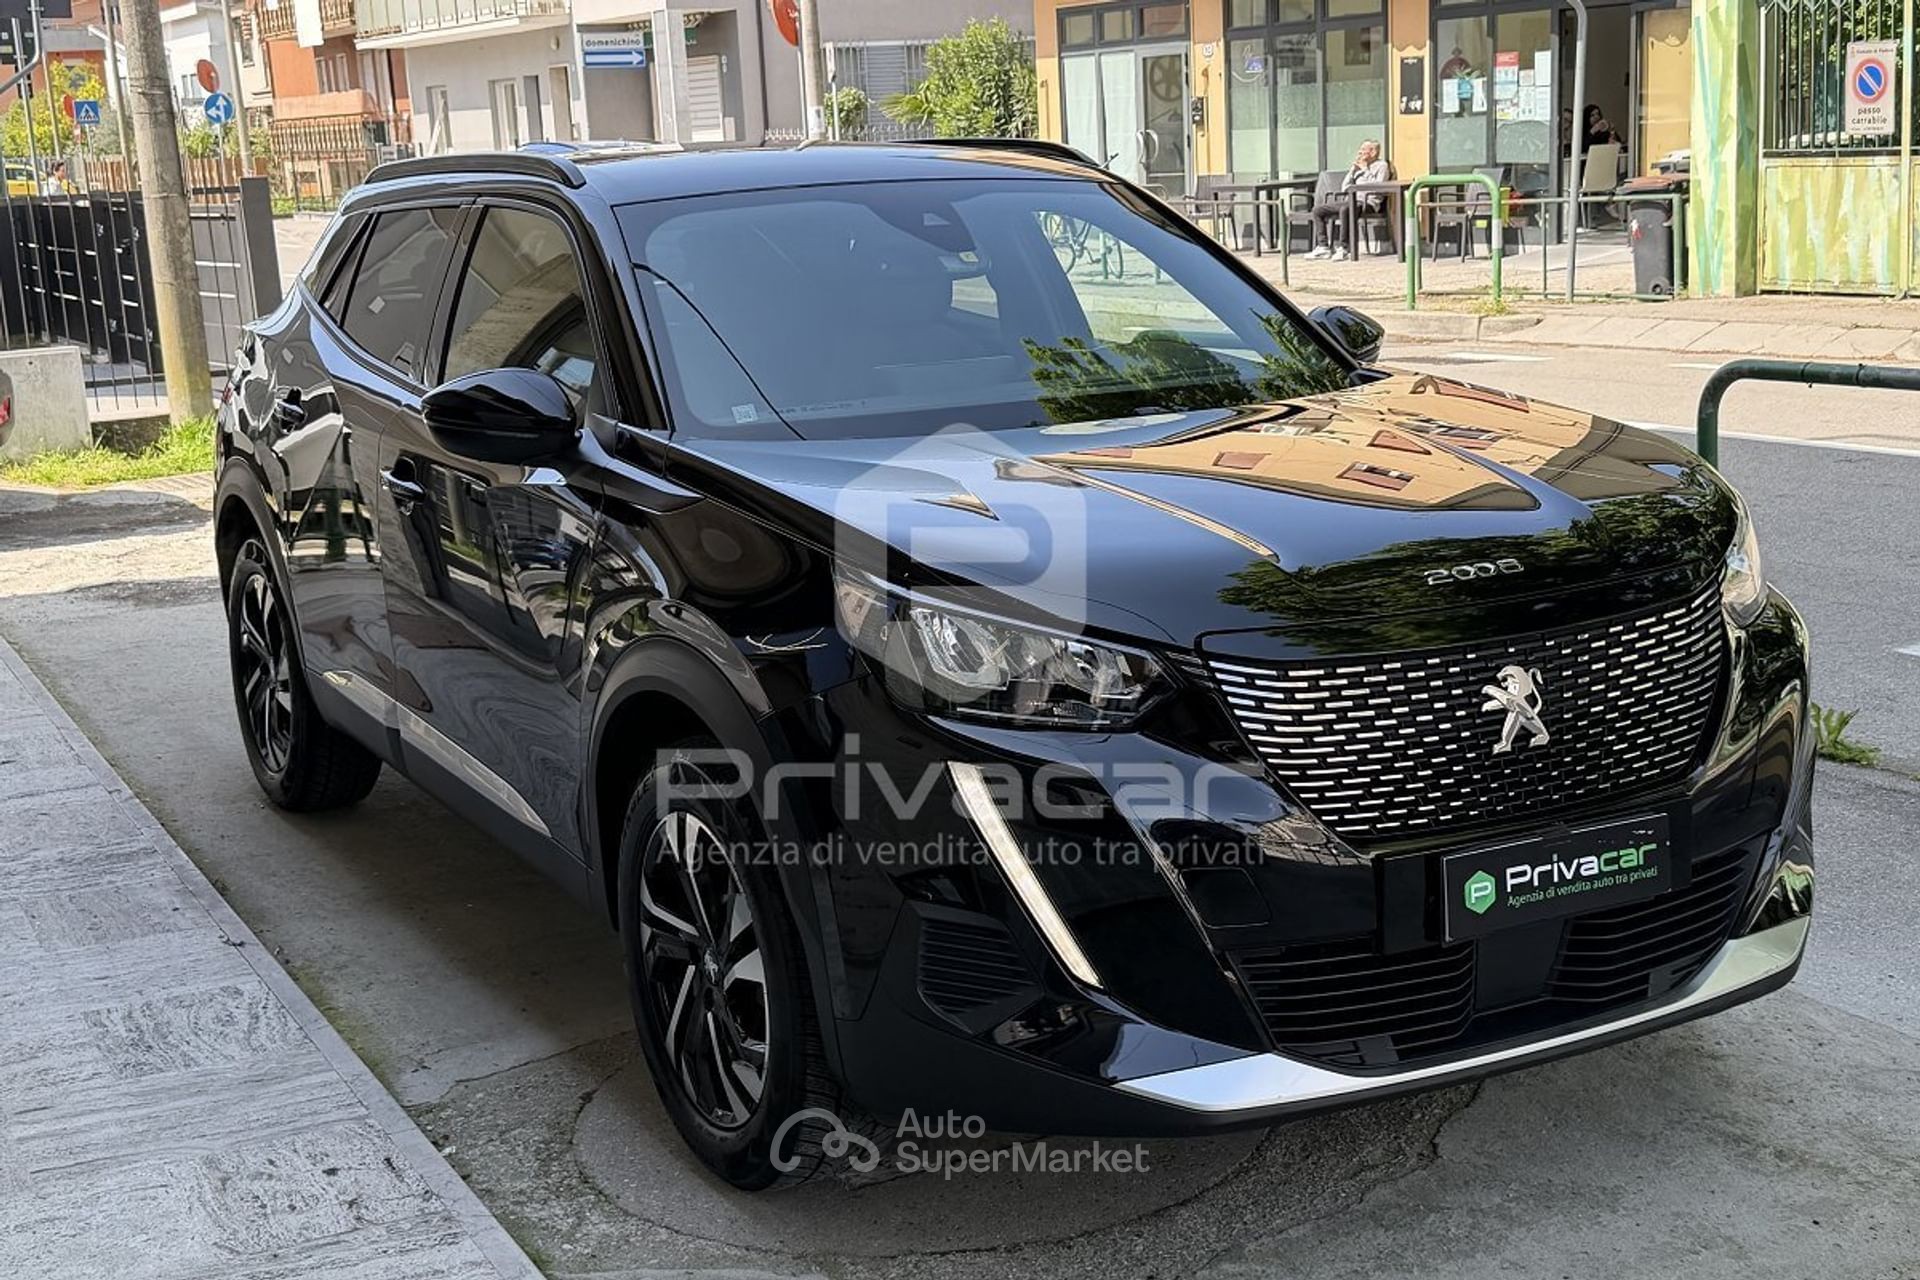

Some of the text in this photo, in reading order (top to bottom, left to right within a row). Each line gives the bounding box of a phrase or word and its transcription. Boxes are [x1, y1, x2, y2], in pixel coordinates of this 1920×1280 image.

[585, 38, 641, 48] domenichino
[1857, 107, 1881, 115] passo
[1851, 116, 1887, 125] carrabile
[1424, 558, 1524, 585] 2008
[1506, 844, 1657, 892] Privacar
[1507, 866, 1658, 908] Agenzia di vendita auto tra privati
